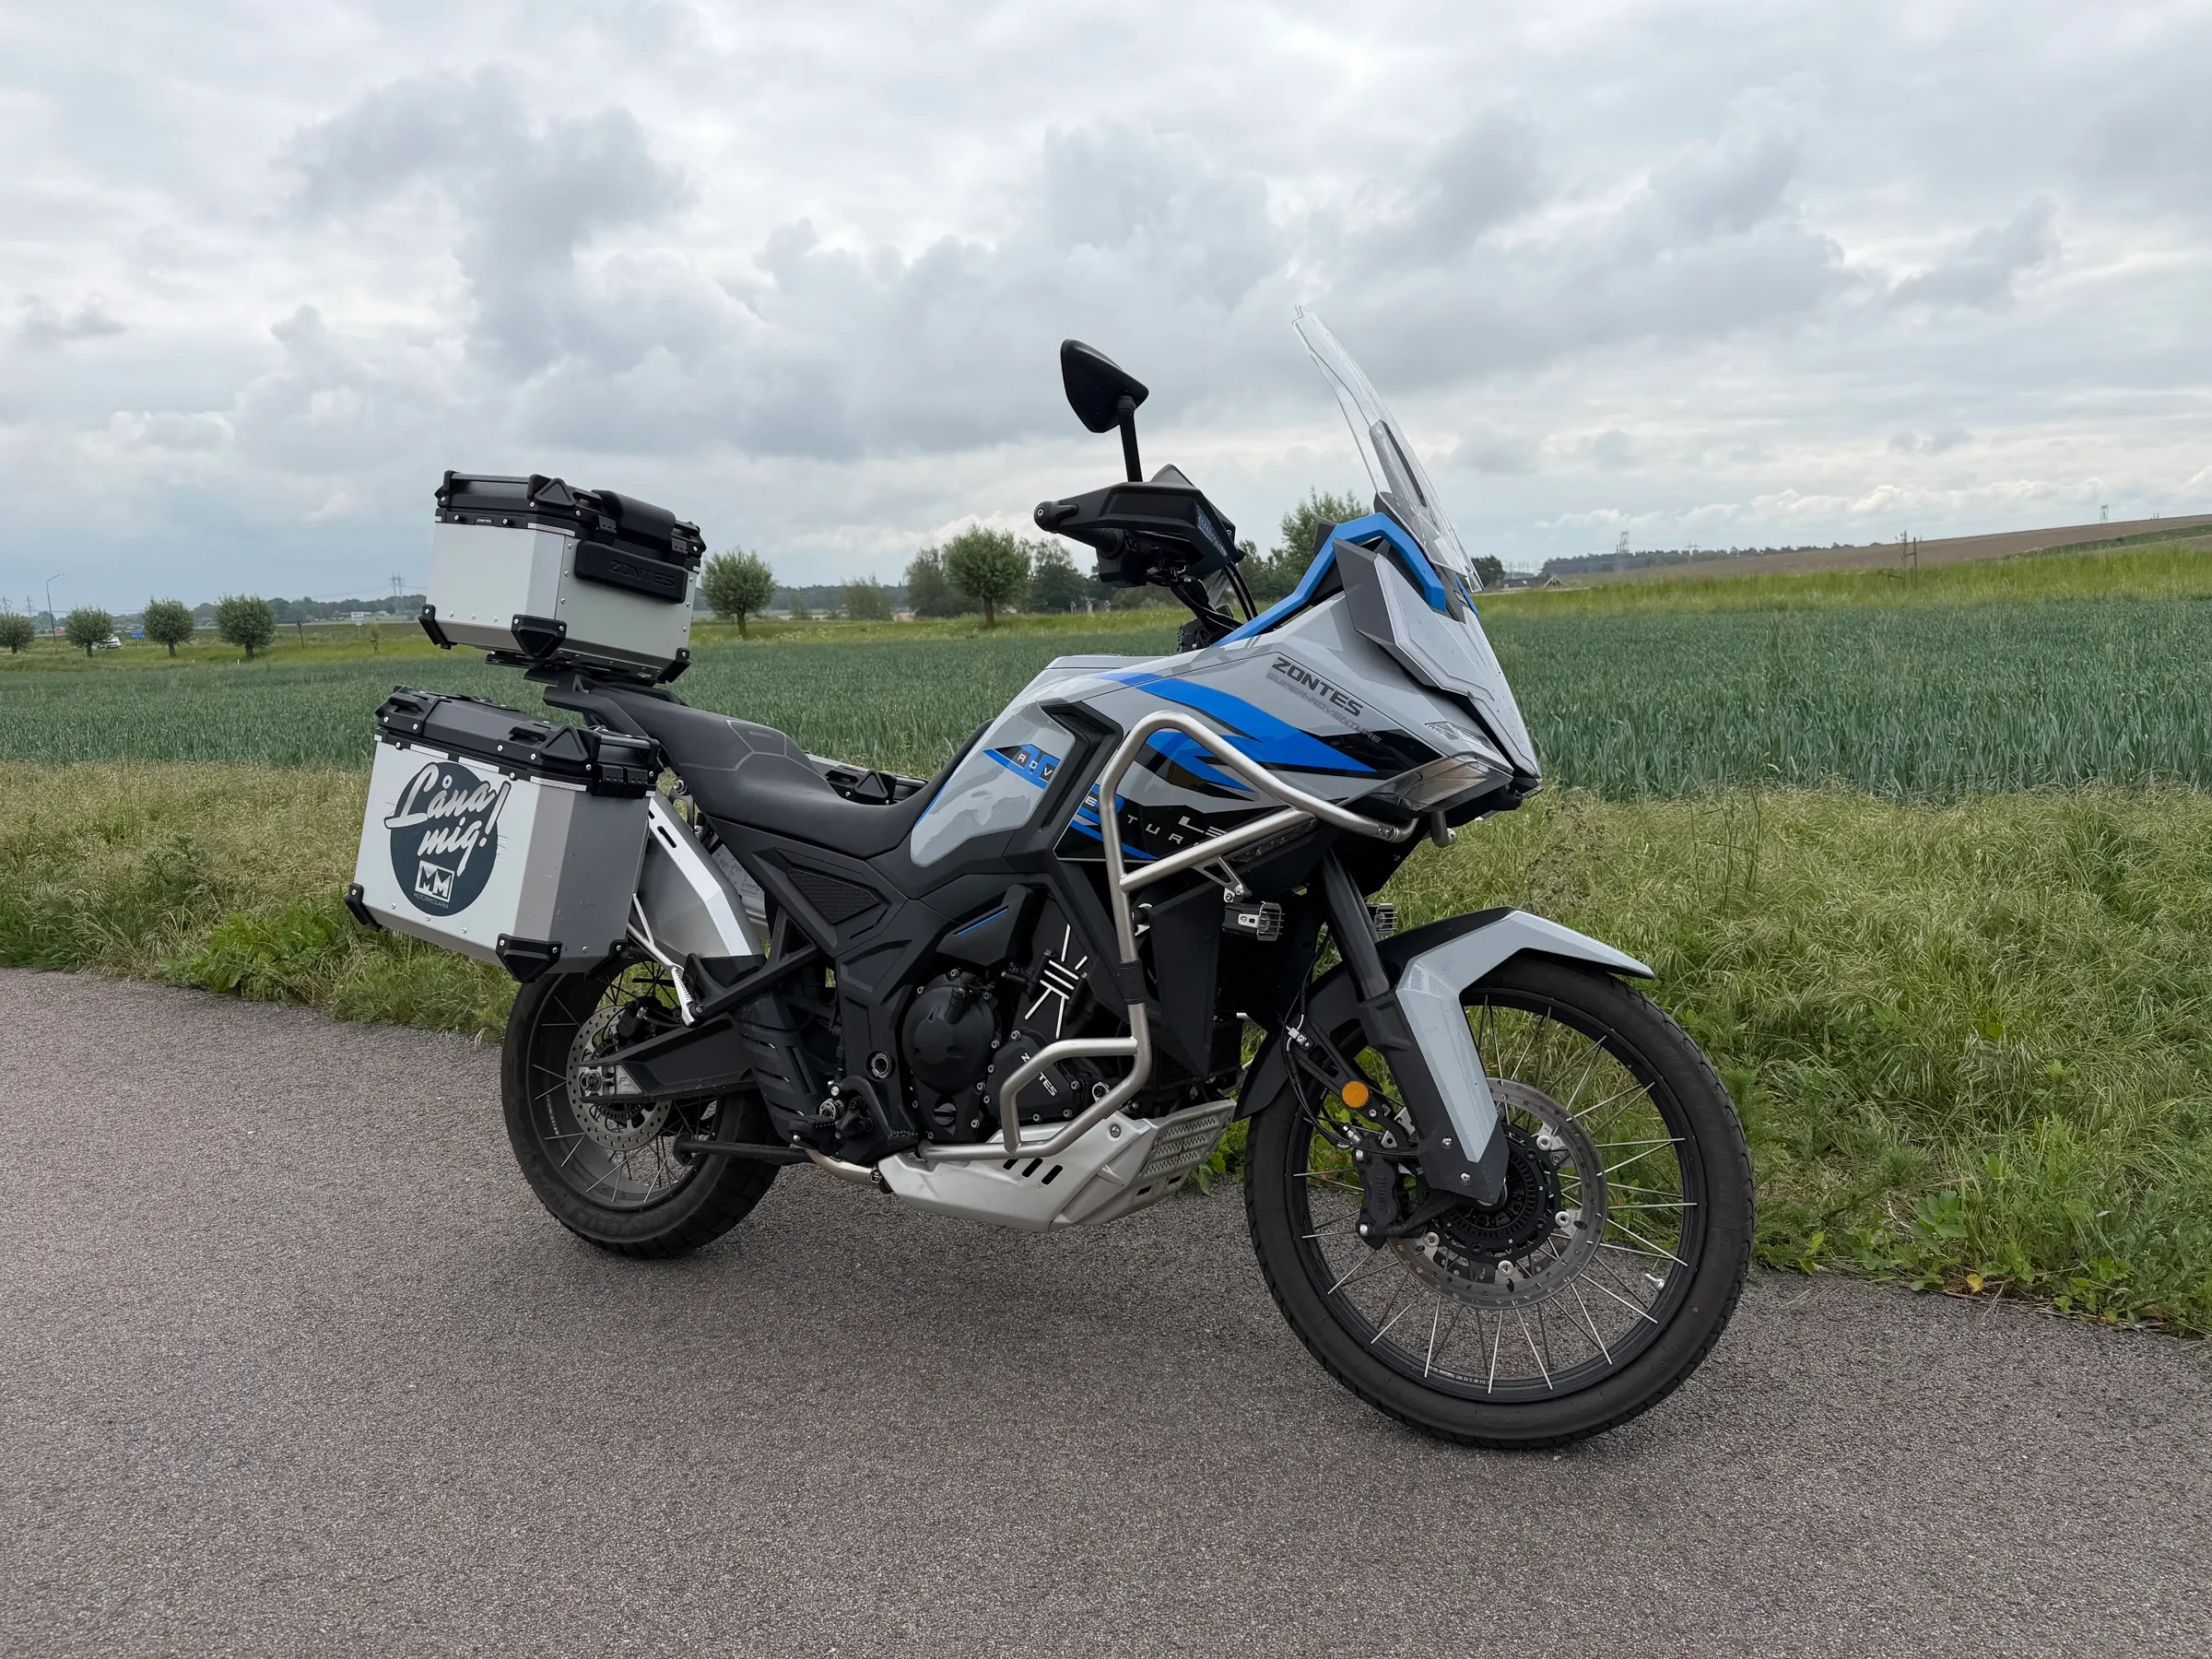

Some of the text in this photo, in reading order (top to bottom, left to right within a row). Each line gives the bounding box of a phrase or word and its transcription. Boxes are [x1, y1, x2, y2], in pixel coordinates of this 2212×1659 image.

[1265, 672, 1382, 744] SUPER-ADVENTURE
[1272, 656, 1364, 717] ZONTES
[385, 763, 496, 829] Låna
[418, 783, 511, 877] mig!
[1020, 1052, 1058, 1097] ZTES
